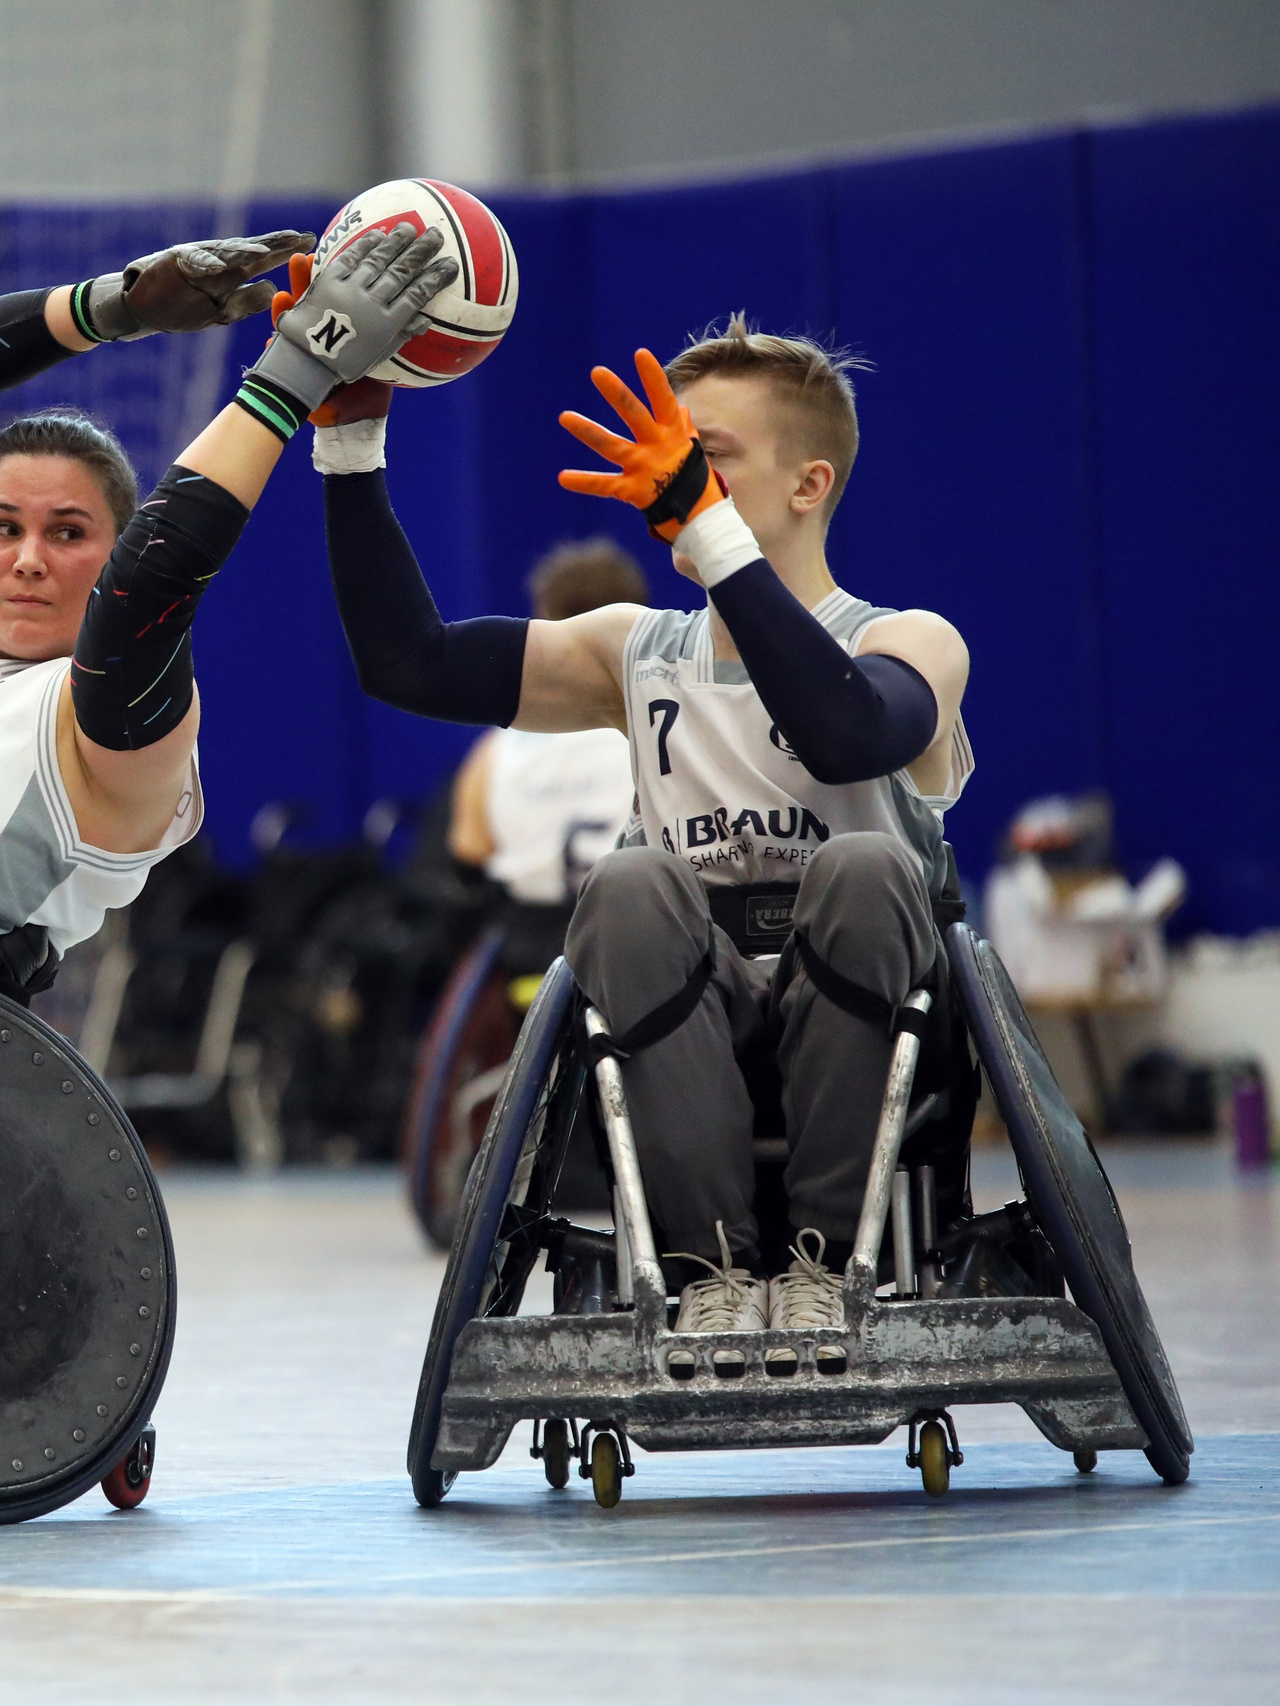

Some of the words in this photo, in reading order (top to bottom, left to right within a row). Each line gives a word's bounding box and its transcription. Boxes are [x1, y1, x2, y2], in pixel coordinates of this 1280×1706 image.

[311, 315, 350, 353] N
[648, 698, 680, 776] 7
[686, 806, 830, 848] BRAUN
